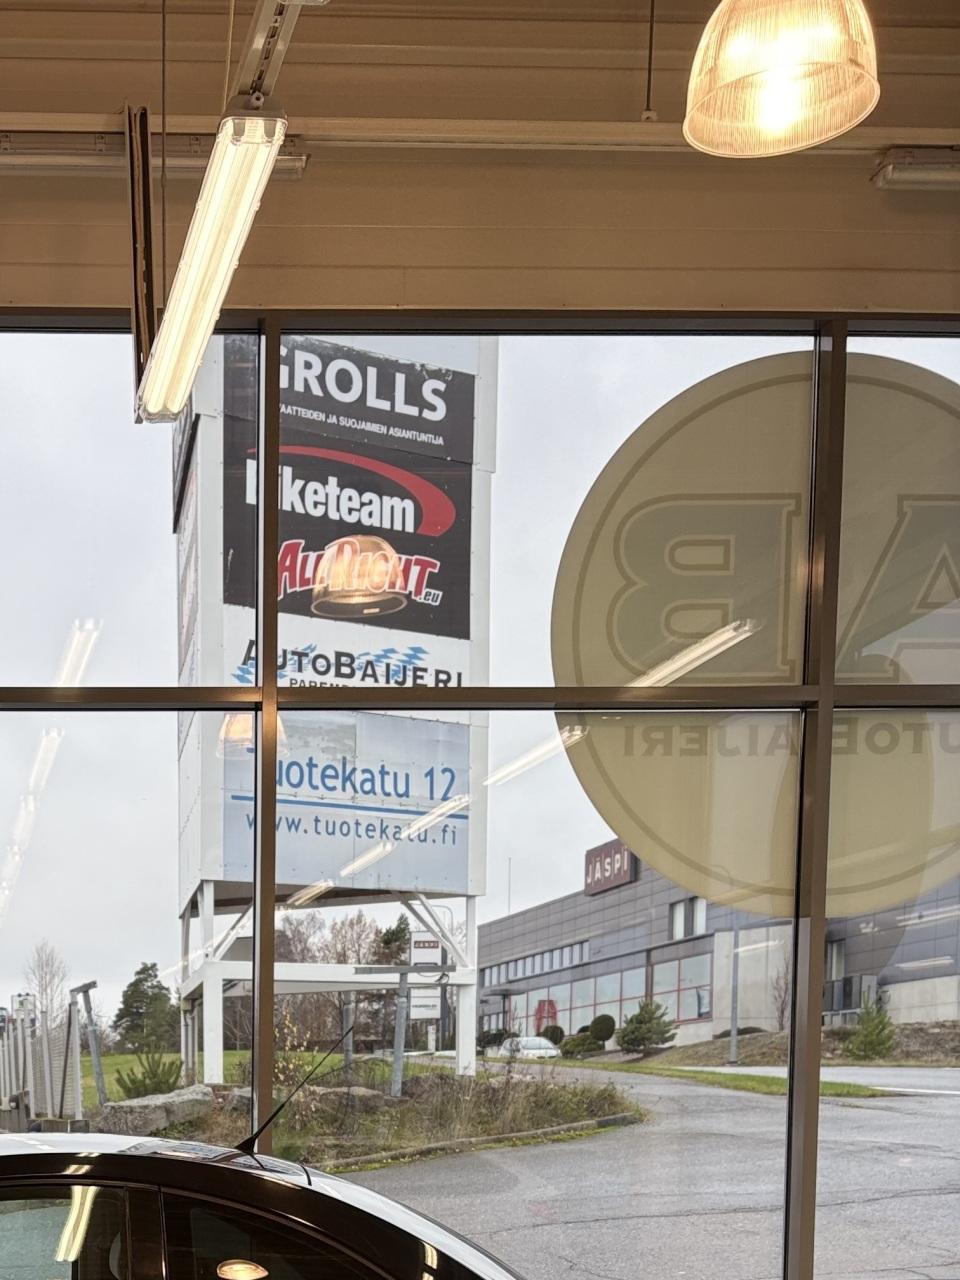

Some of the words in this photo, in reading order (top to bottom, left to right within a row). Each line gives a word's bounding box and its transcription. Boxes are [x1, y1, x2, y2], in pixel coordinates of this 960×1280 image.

[280, 403, 325, 422] AATTEIDEN
[327, 413, 338, 425] JA
[245, 458, 415, 532] keteam
[247, 747, 410, 799] uotekatu
[424, 765, 456, 802] 12
